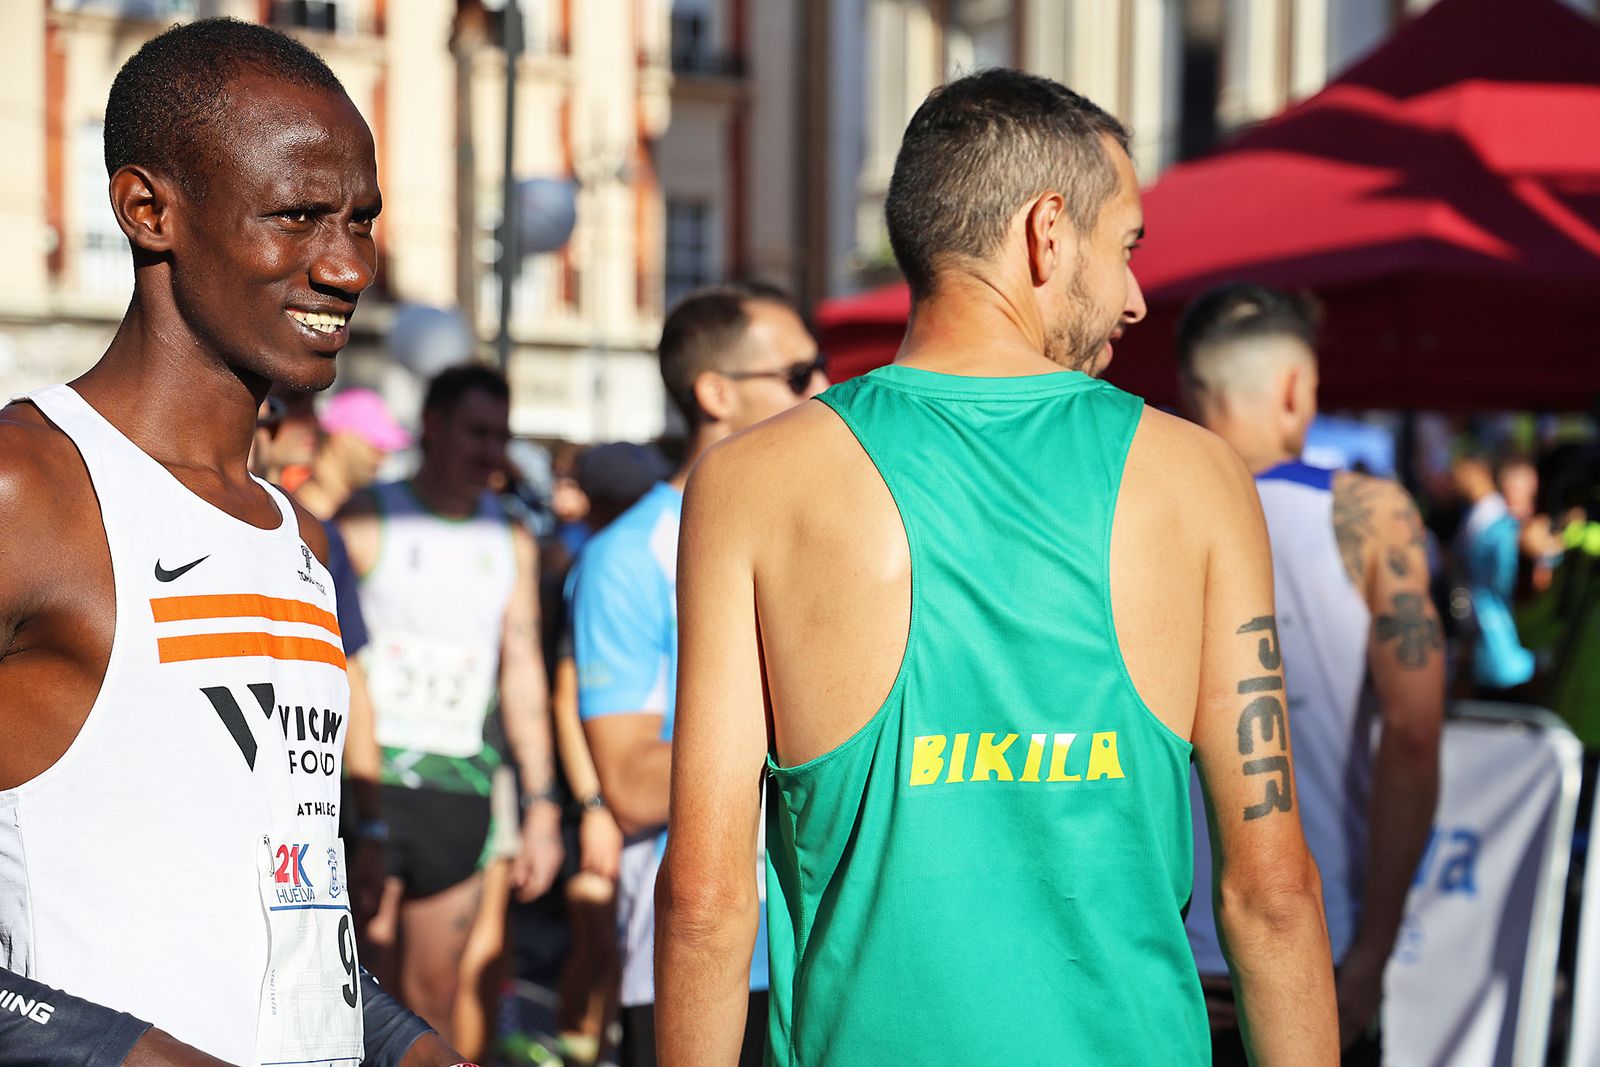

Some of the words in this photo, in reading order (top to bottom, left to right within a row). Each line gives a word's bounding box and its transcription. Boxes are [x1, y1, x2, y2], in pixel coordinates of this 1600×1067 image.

[1236, 615, 1292, 821] PIER
[909, 731, 1126, 787] BIKILA
[275, 843, 313, 887] 21K
[276, 888, 316, 904] HUELVA
